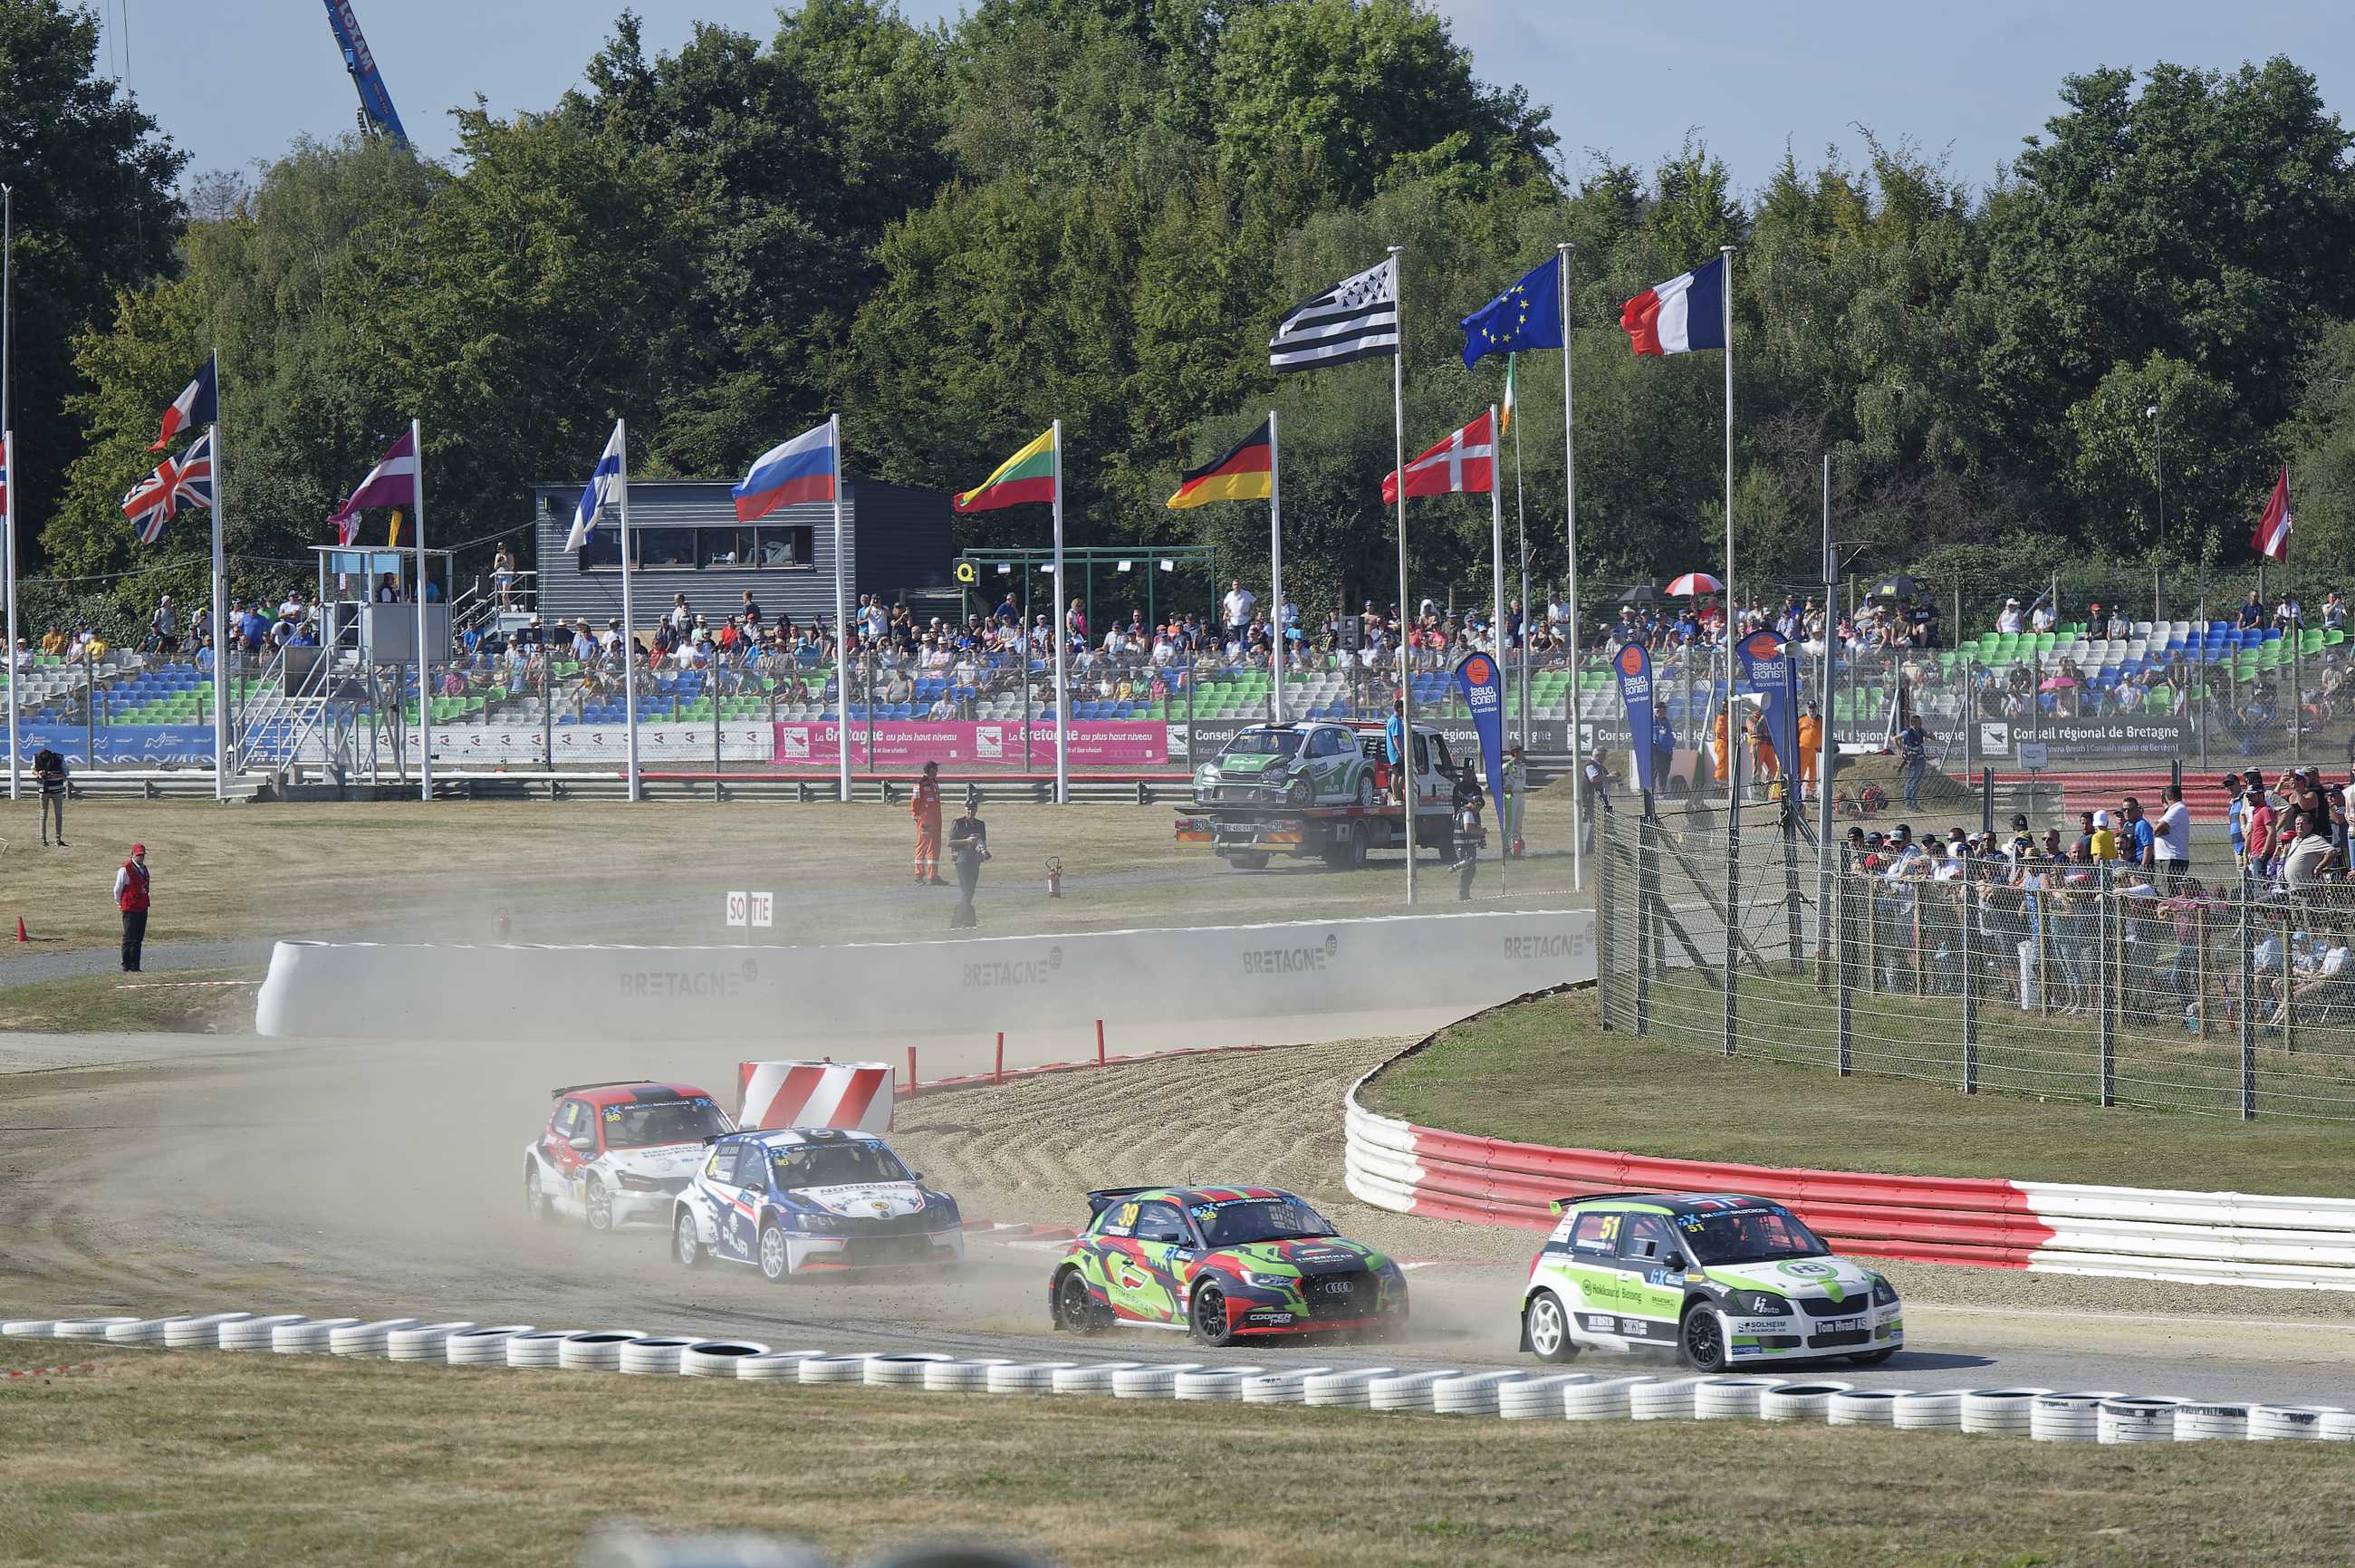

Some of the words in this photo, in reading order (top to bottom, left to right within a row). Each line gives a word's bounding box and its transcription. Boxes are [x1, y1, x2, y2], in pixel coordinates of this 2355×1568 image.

[339, 1, 374, 72] LOXAM
[956, 563, 974, 582] Q
[897, 732, 912, 743] plus
[913, 732, 931, 741] haut
[932, 732, 957, 741] niveau
[1091, 731, 1108, 743] plus
[1108, 731, 1126, 741] haut
[1127, 732, 1152, 741] niveau
[1195, 728, 1235, 741] Conseil
[2058, 726, 2106, 742] régional
[2108, 726, 2123, 738] de
[2126, 726, 2178, 740] Bretagne
[730, 897, 769, 920] SOTIE
[1504, 935, 1584, 959] BRETAGNE
[1243, 947, 1326, 974] BRETAGNE
[963, 959, 1048, 986] BRETAGNE
[619, 971, 740, 997] BRETAGNE
[1118, 1202, 1139, 1227] 39
[1599, 1216, 1621, 1240] 51
[1687, 1222, 1705, 1233] 51
[1250, 1313, 1293, 1321] COOPER
[1817, 1322, 1834, 1333] Tom
[1857, 1318, 1866, 1330] AS
